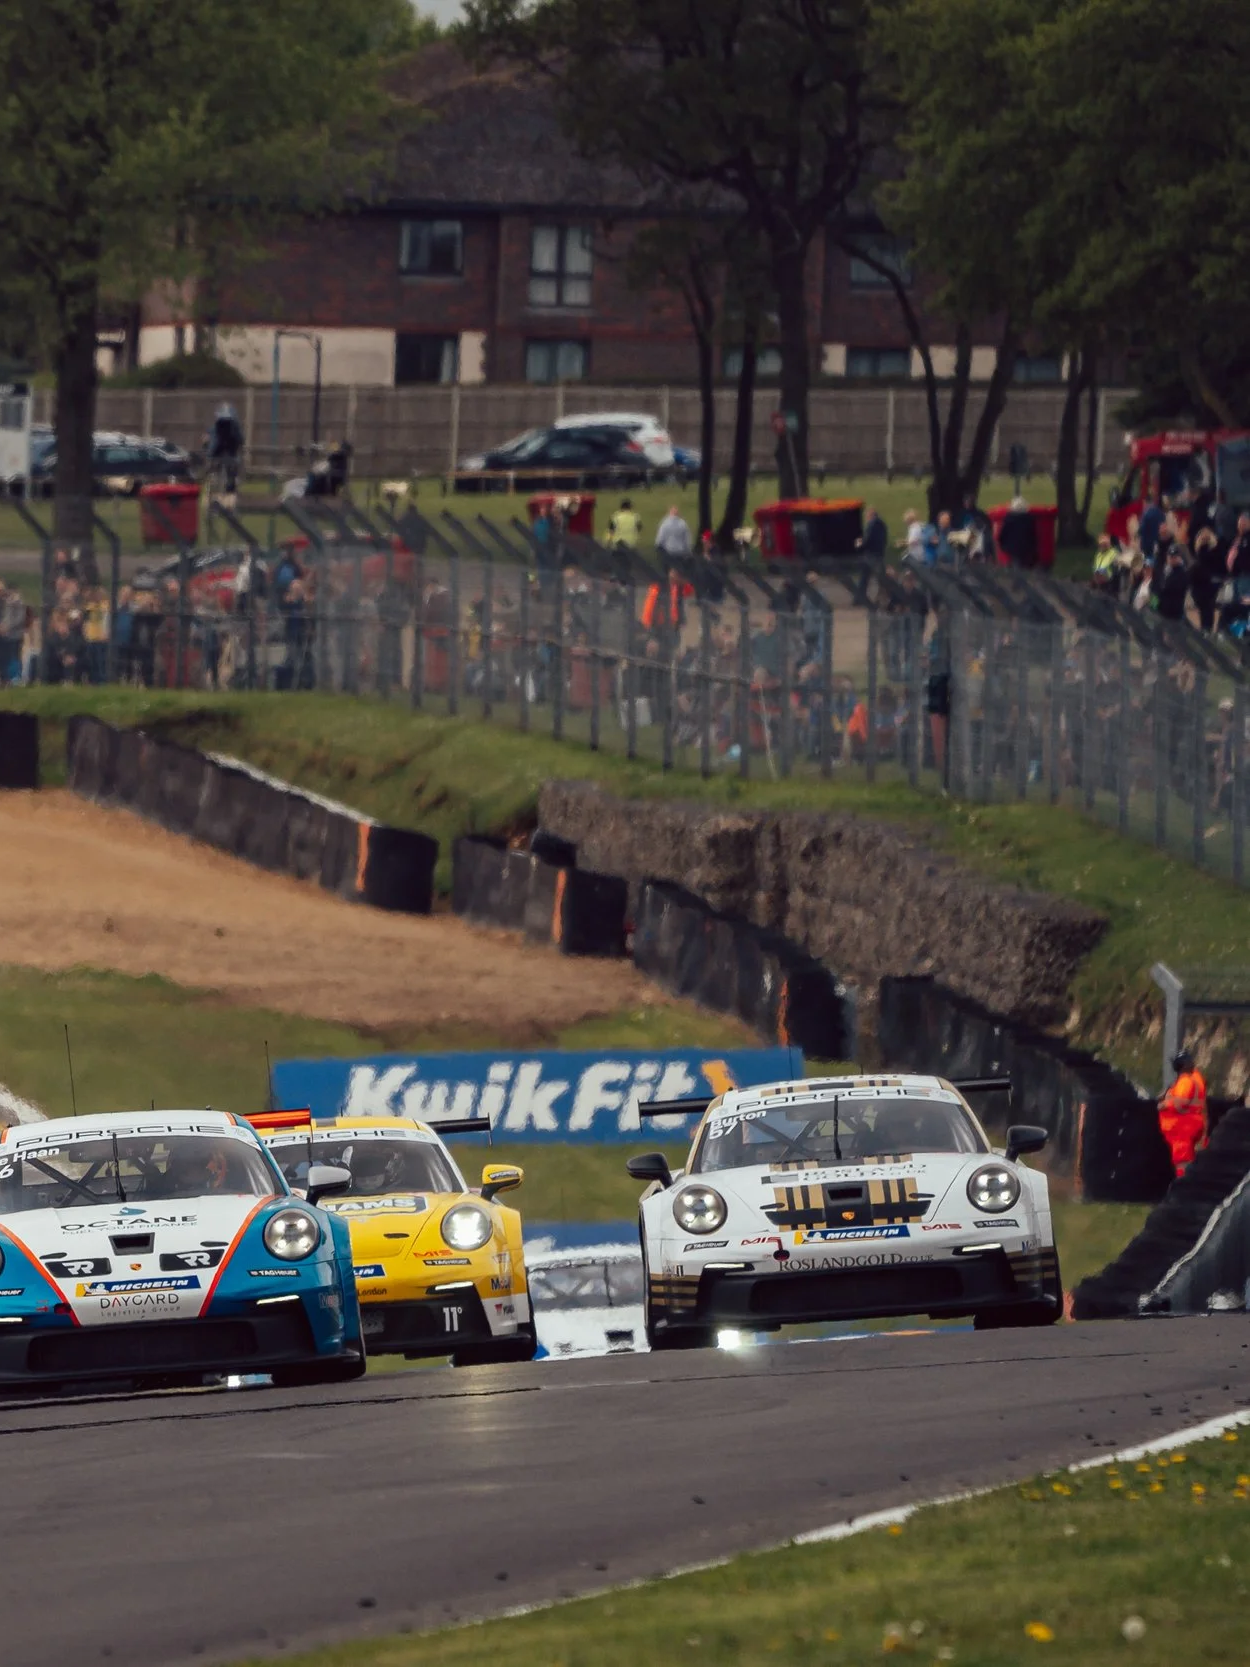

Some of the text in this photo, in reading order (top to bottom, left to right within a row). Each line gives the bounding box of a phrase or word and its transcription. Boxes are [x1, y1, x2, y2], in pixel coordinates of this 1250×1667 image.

[344, 1060, 697, 1131] Kwik Fit
[736, 1088, 930, 1111] PORSCHE
[709, 1110, 767, 1129] Burton
[16, 1125, 225, 1148] PORSCHE
[264, 1130, 407, 1145] RSCHE
[708, 1121, 738, 1140] 57
[12, 1147, 60, 1163] Haan
[60, 1214, 198, 1232] OCTANE
[825, 1228, 900, 1240] MICHELIN
[110, 1278, 189, 1292] MICHELIN
